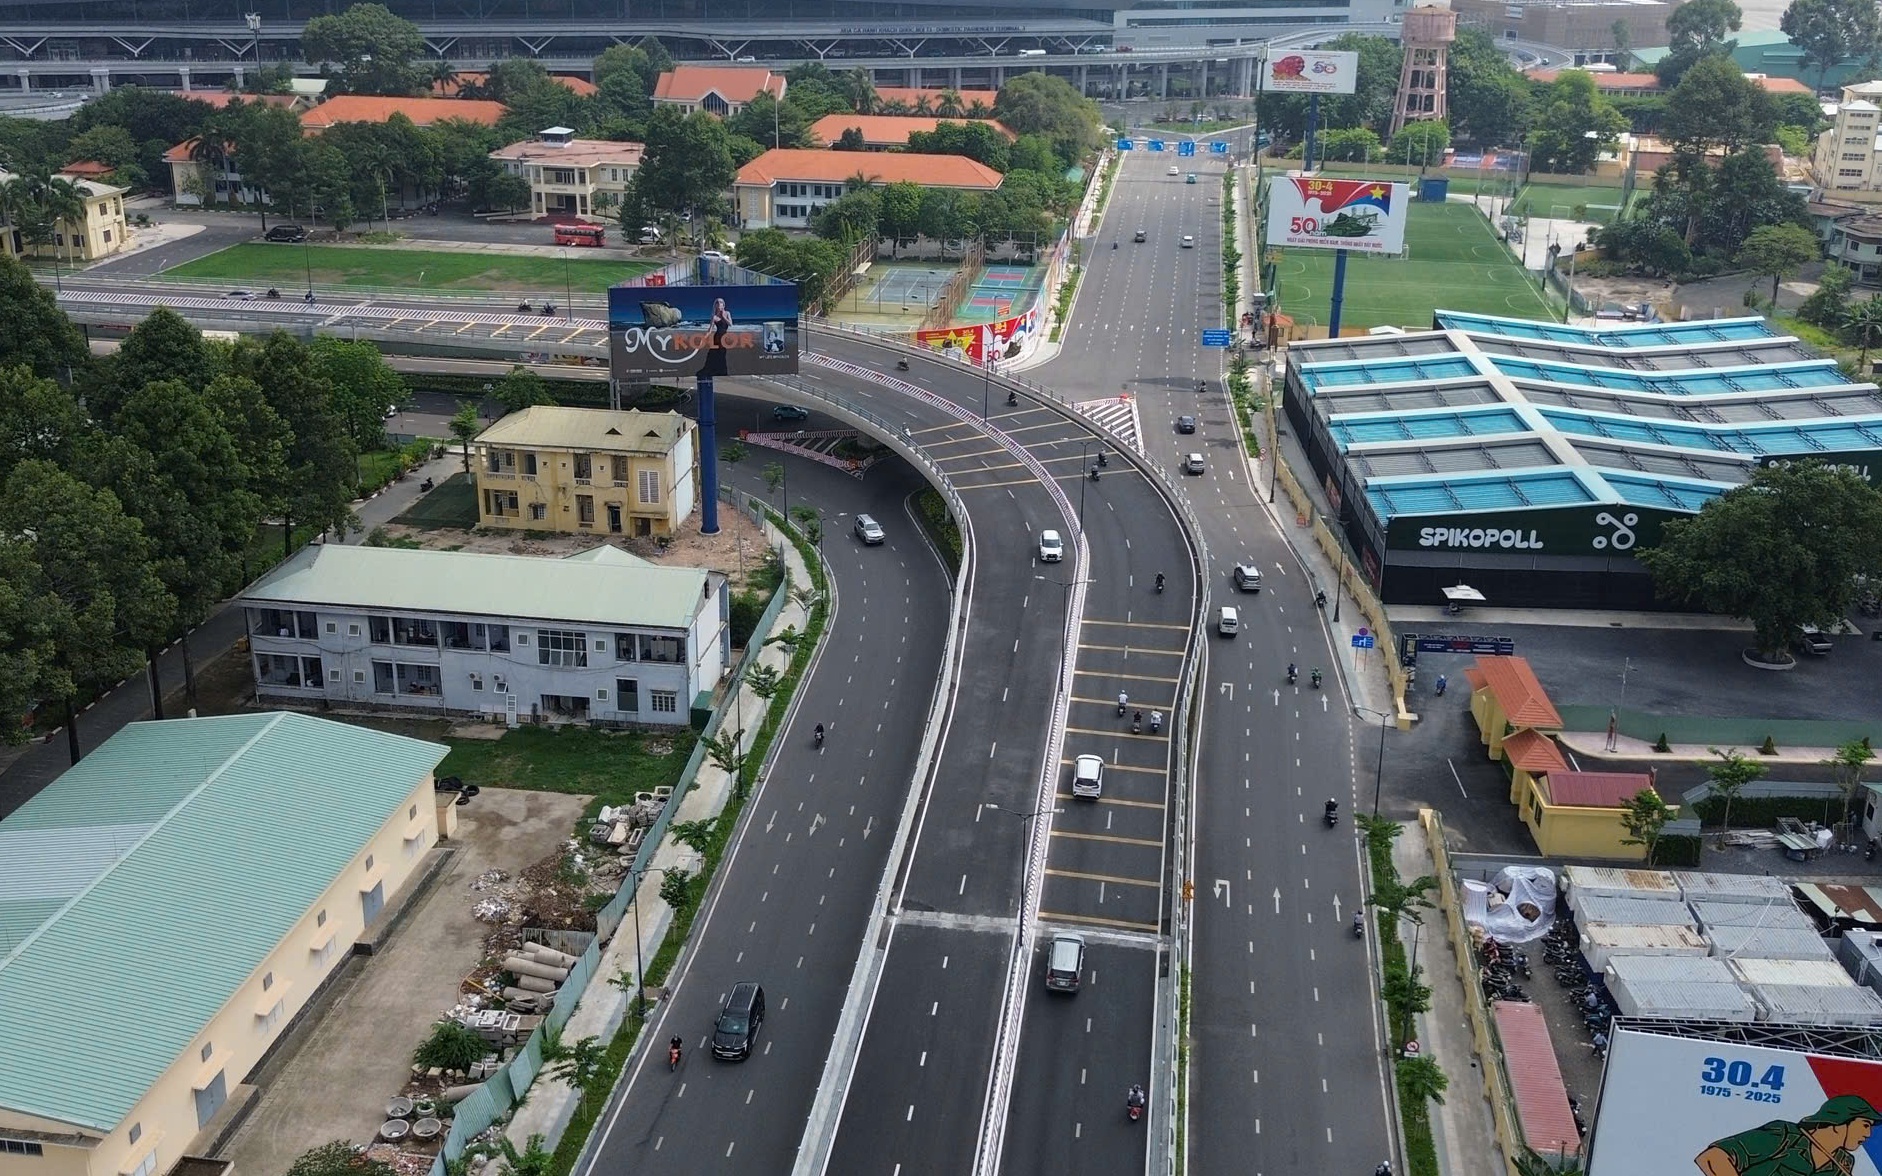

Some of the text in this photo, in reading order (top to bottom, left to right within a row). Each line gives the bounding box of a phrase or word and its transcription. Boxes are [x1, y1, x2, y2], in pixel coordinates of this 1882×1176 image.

[1308, 181, 1333, 191] 30-4
[1290, 217, 1318, 234] 50
[1419, 527, 1543, 549] SPIKOPOLL
[1701, 1057, 1785, 1090] 30.4
[1700, 1085, 1731, 1097] 1975
[1745, 1091, 1781, 1103] 2025
